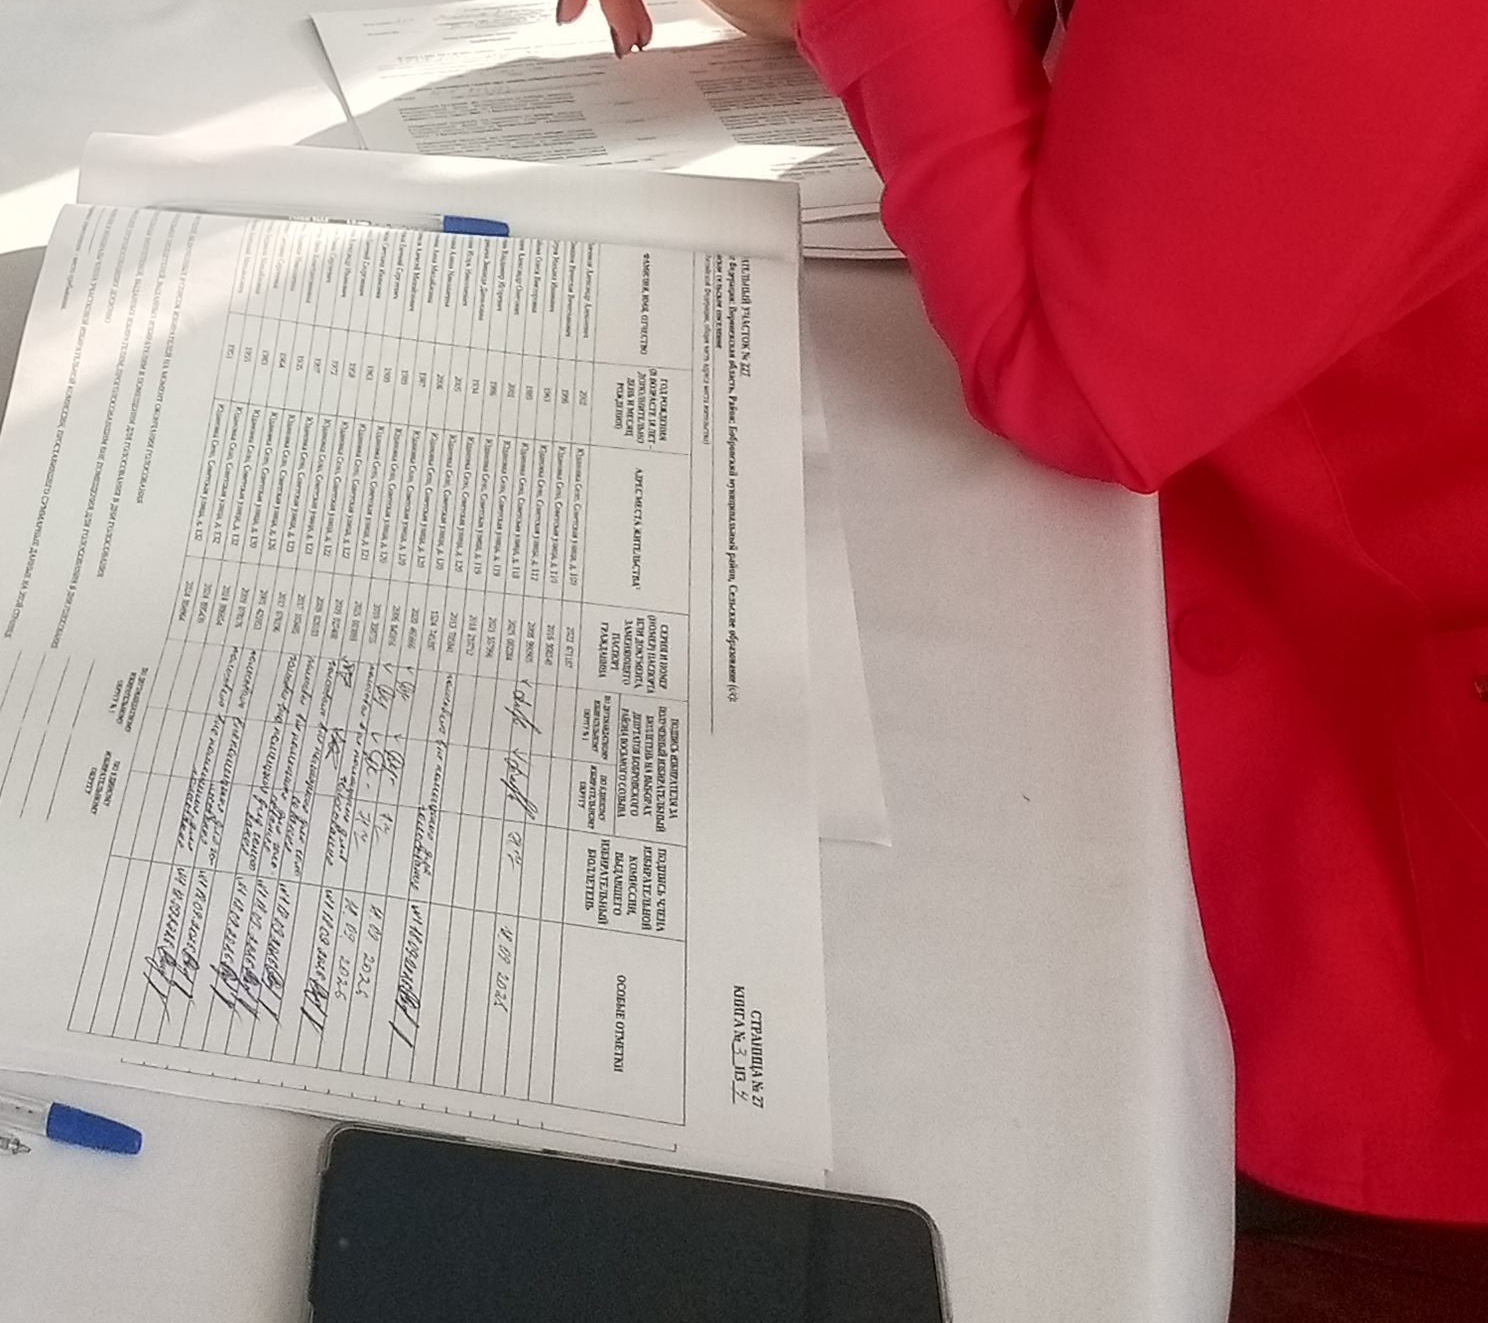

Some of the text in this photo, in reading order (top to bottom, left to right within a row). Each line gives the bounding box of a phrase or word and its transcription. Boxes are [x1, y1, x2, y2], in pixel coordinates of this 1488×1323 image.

[727, 307, 737, 358] Воронежская
[741, 307, 751, 349] УЧАСТОК
[740, 362, 751, 377] 227
[658, 379, 668, 441] ГОД РОЖДЕНИЯ
[727, 426, 738, 476] Бобровский
[585, 848, 596, 911] БЮЛЛЕТЕНЬ
[598, 839, 610, 925] ИЗБИРАТЕЛЬНЫЙ
[612, 852, 624, 916] ВЫДАВШЕГО
[626, 855, 638, 915] КОМИССИИ,
[641, 846, 653, 930] ИЗБИРАТЕЛЬНОЙ
[655, 848, 667, 932] ПОДПИСЬ ЧЛЕНА
[613, 975, 627, 1072] ОСОБЫЕ ОТМЕТКИ
[734, 985, 745, 1027] КНИГА
[734, 1030, 746, 1041] №
[749, 1010, 764, 1108] СТРАНИЦА № 27
